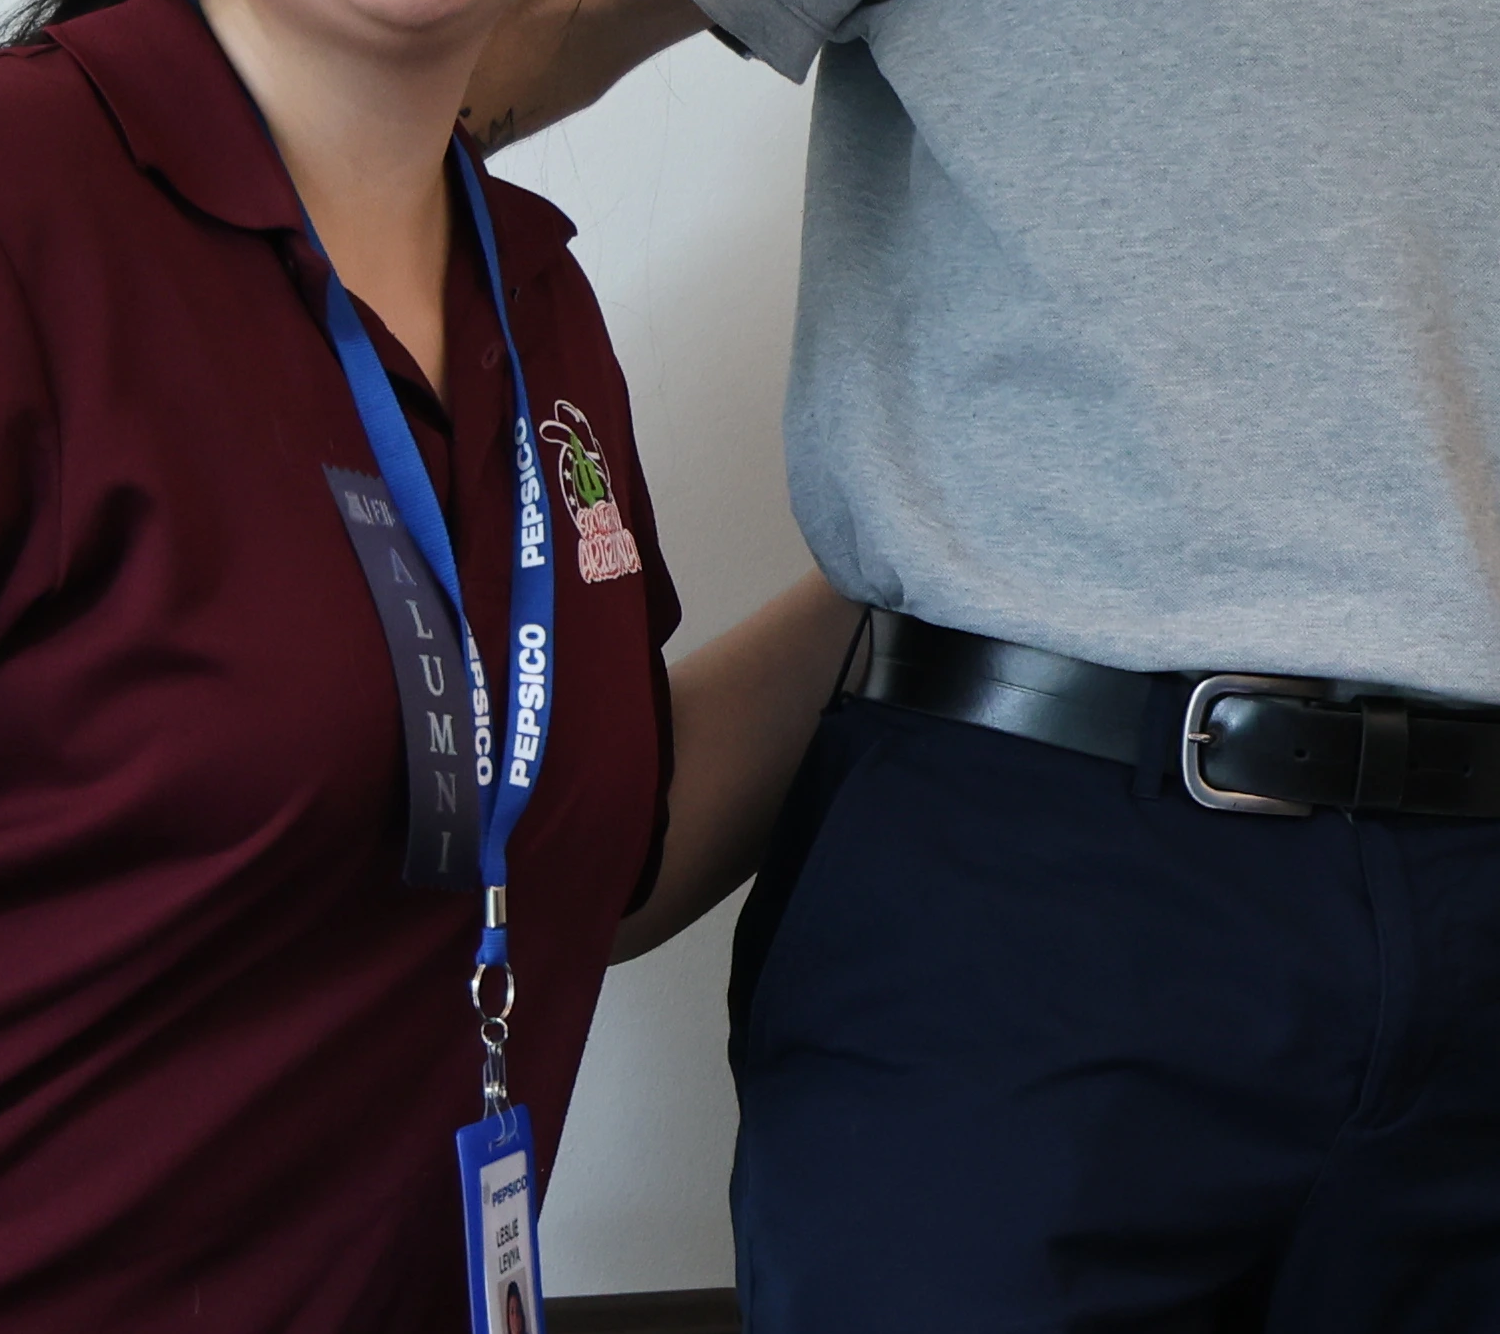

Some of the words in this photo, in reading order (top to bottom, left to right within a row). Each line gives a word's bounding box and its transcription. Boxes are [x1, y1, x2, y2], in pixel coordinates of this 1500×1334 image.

[512, 415, 548, 570] PEPSICO
[390, 545, 458, 875] ALUMNI
[508, 622, 548, 788] PEPSICO
[492, 1174, 528, 1208] PEPSICO
[496, 1218, 520, 1249] LESLIE
